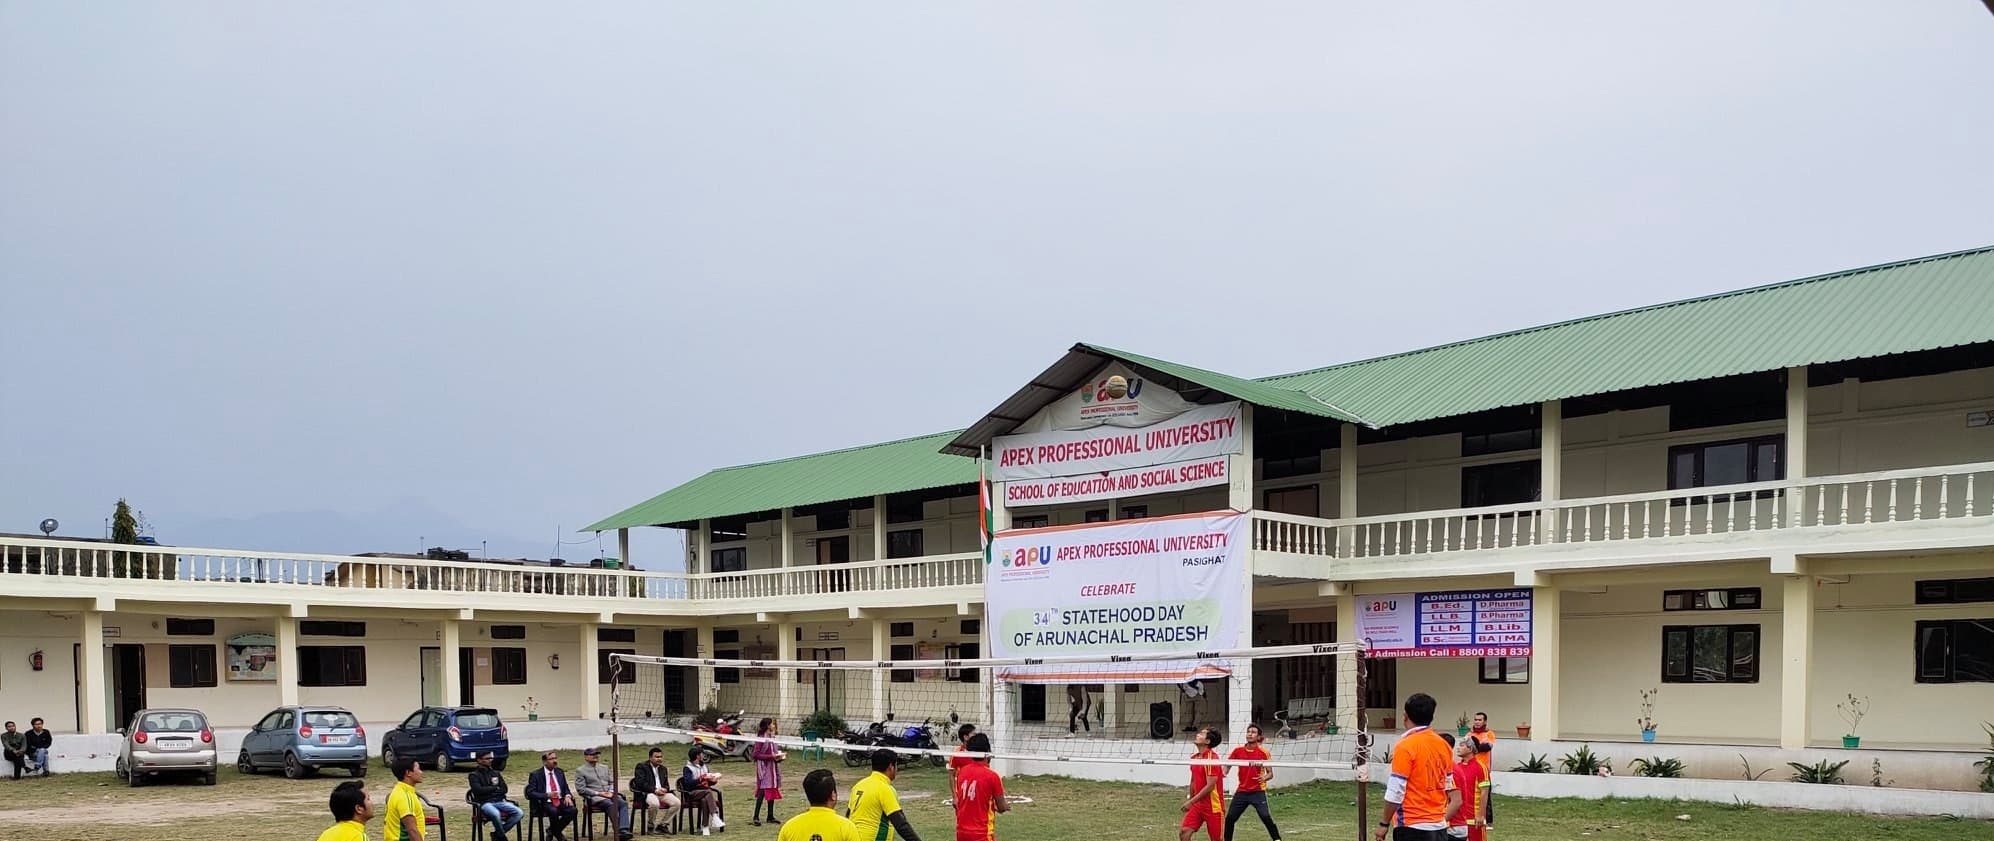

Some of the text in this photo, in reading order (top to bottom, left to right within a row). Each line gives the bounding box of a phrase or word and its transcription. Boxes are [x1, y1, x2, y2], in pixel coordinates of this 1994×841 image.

[1000, 417, 1236, 467] APEX PROFESSIONAL UNIVERSITY
[1008, 461, 1225, 501] SCHOOL OF EDUCATION AND SOCIAL SCIENCE
[1056, 533, 1228, 561] APEX PROFESSIONAL UNIVERSITY
[1182, 555, 1225, 567] PASIGHAT
[1080, 583, 1136, 597] CELEBRATE
[1422, 591, 1530, 601] ADMISSION OPEN
[1062, 606, 1155, 625] STATEHOOD
[1158, 605, 1185, 621] DAY
[1014, 625, 1208, 647] OF ARUNACHAL PRADESH
[1312, 645, 1338, 653] Vixen
[1459, 648, 1484, 656] 8800
[961, 780, 977, 800] 14
[854, 790, 863, 812] 7
